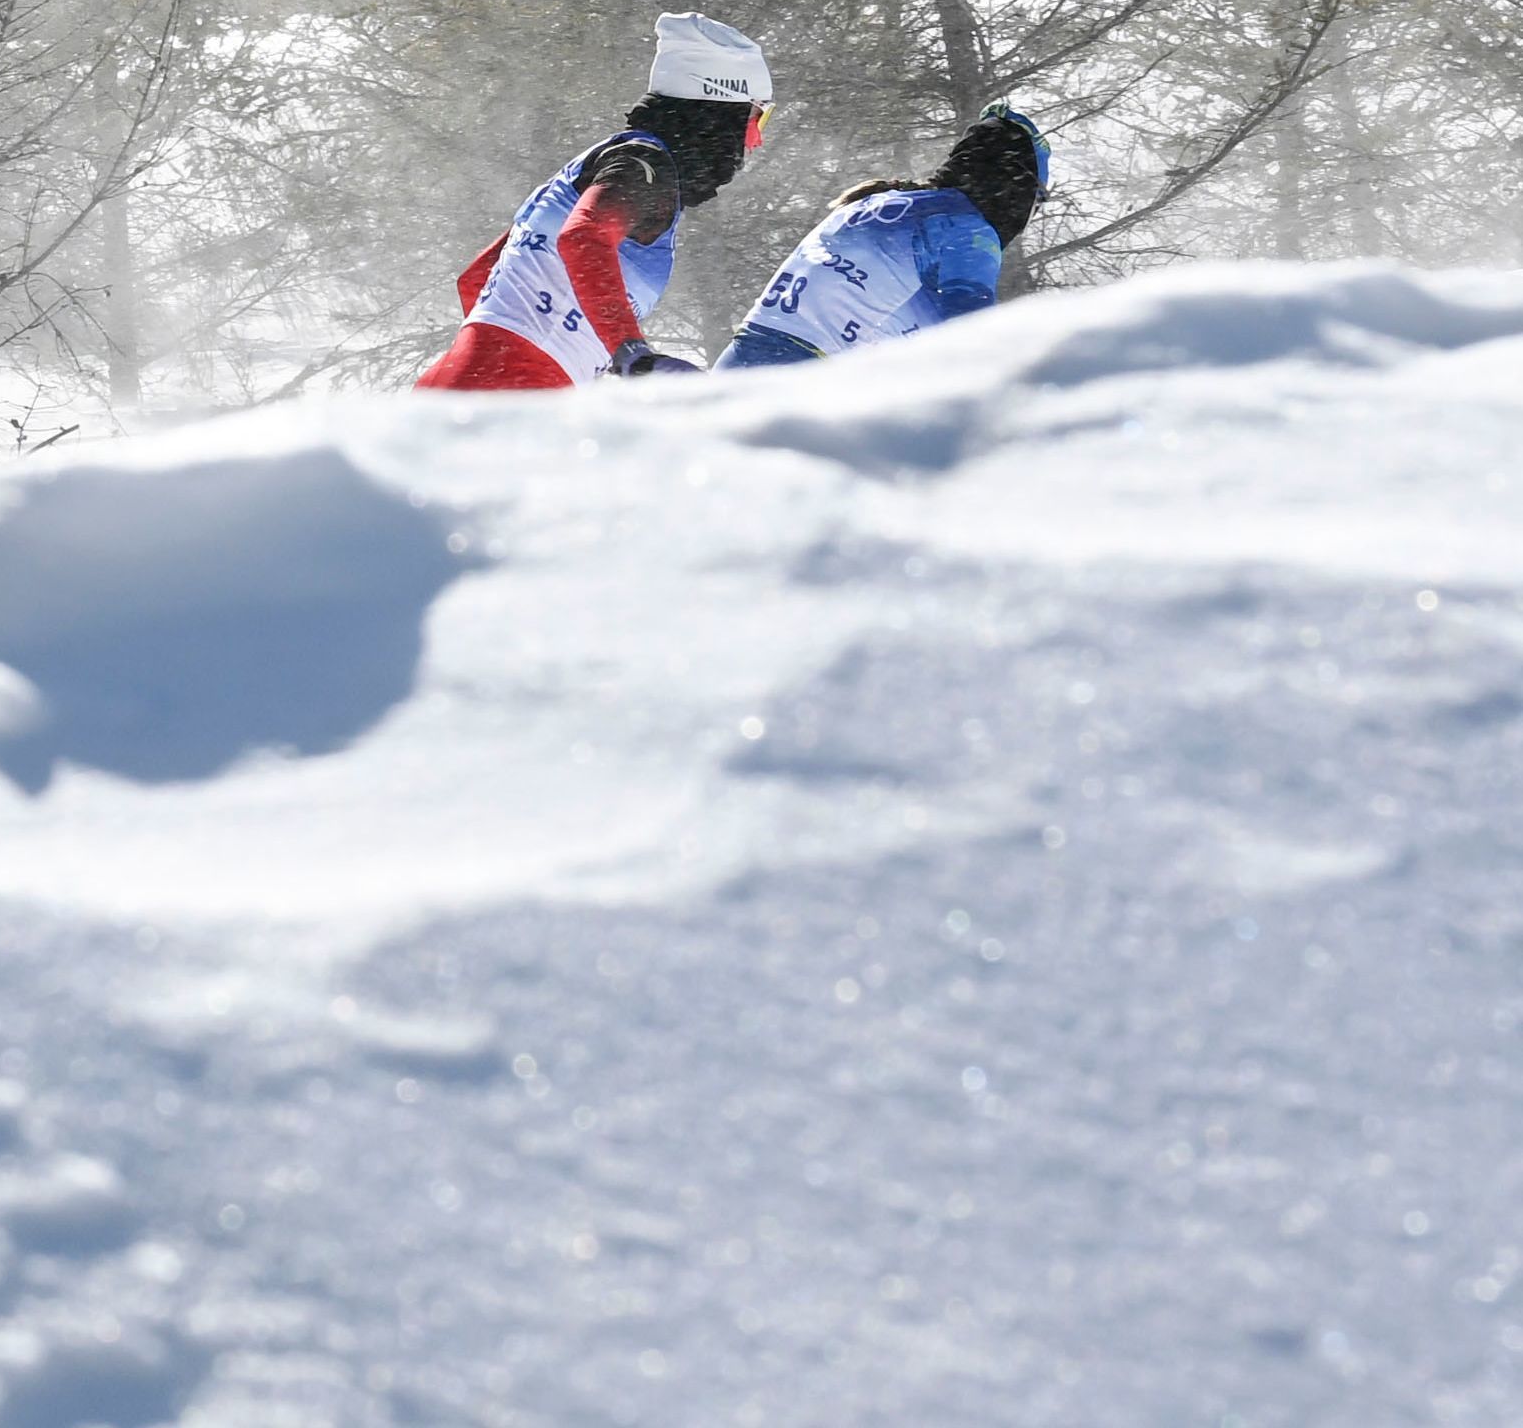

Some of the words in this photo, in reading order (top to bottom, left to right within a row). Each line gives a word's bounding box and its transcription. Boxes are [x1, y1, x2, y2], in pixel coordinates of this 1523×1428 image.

[703, 77, 749, 98] CHINA
[822, 251, 868, 291] 022
[536, 291, 553, 314] 3
[562, 308, 582, 332] 5
[761, 272, 807, 314] 58
[841, 320, 860, 343] 5
